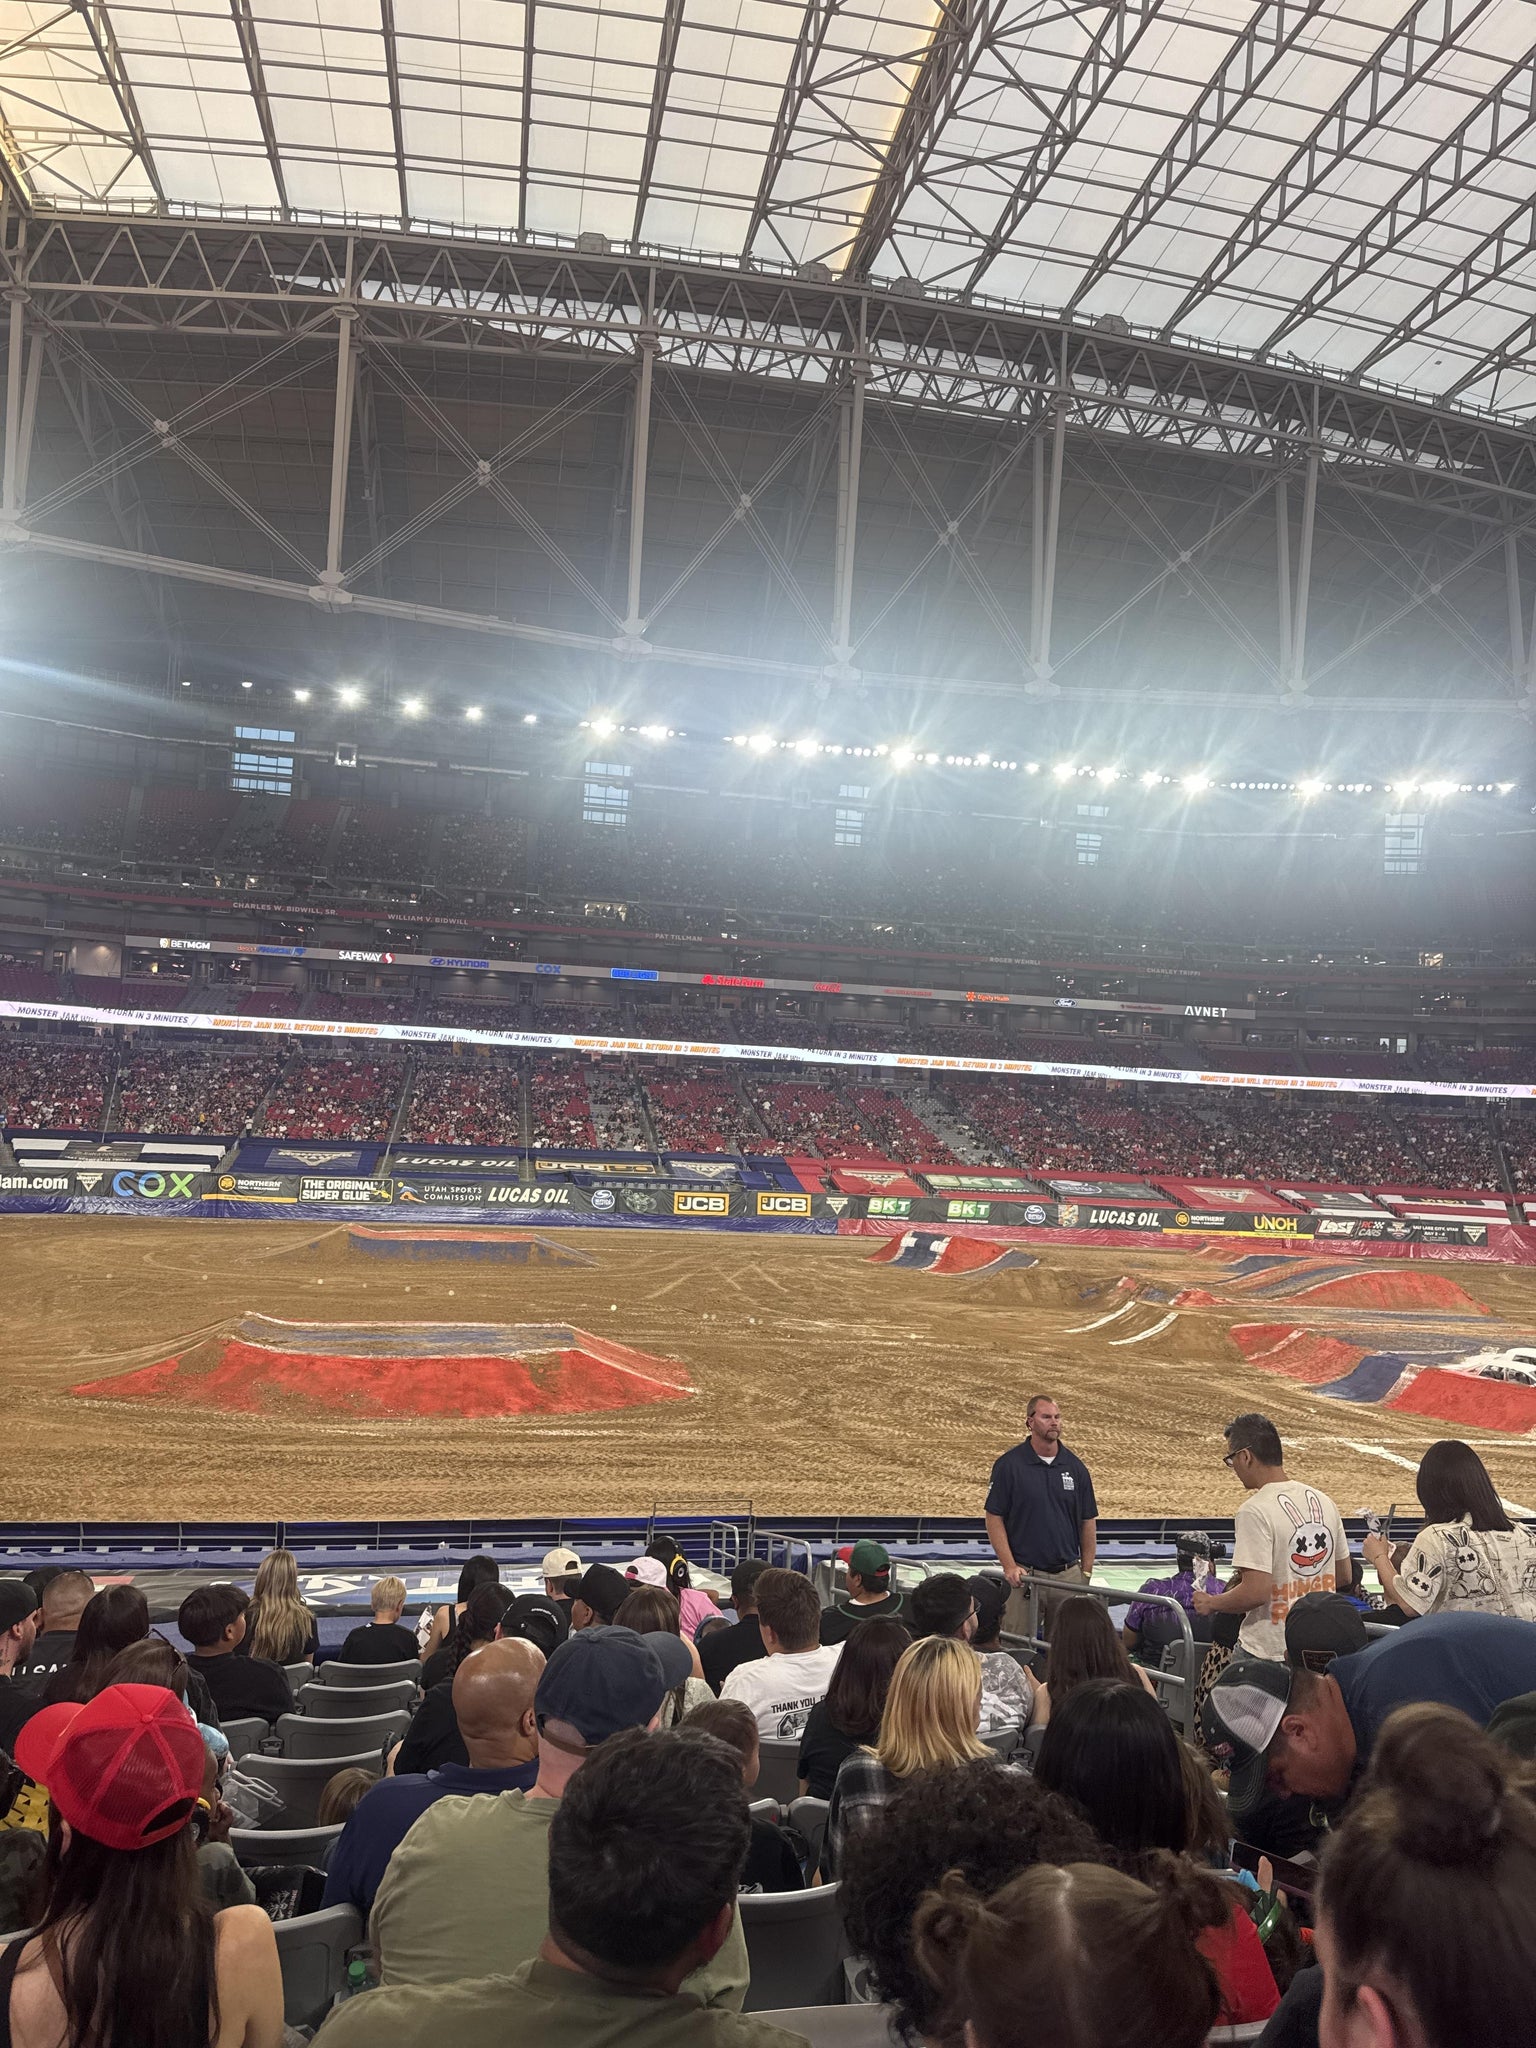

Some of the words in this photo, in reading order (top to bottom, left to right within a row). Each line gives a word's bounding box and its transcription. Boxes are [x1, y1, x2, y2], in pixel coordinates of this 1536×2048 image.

[232, 902, 272, 911] CHARLES
[273, 904, 285, 912] W.
[324, 908, 338, 916] SR.
[388, 913, 424, 922] WILLIAM
[426, 914, 433, 922] V.
[434, 916, 469, 926] BIDWILL
[654, 932, 669, 940] PAT
[671, 934, 703, 942] TILLMAN
[170, 938, 211, 950] BETMGM
[338, 950, 383, 962] SAFEWAY
[446, 958, 490, 969] HYUNDAI
[536, 964, 561, 974] COX
[1146, 967, 1178, 976] CHARLEY
[16, 1006, 58, 1018] MONSTER
[135, 1010, 144, 1019] IN
[152, 1012, 189, 1024] MINUTES
[1184, 1005, 1228, 1018] AVNET
[212, 1018, 252, 1028] MONSTER
[254, 1020, 271, 1029] JAM
[273, 1022, 292, 1030] WILL
[294, 1022, 325, 1033] RETURN
[344, 1025, 379, 1036] MINUTES
[400, 1030, 437, 1040] MONSTER
[505, 1032, 514, 1040] IN
[520, 1034, 553, 1044] MINUTES
[574, 1038, 609, 1047] MONSTER
[610, 1038, 626, 1048] JAM
[627, 1040, 644, 1050] WILL
[645, 1042, 673, 1052] RETURN
[690, 1045, 721, 1054] MINUTES
[740, 1048, 772, 1058] MONSTER
[834, 1050, 842, 1058] IN
[848, 1052, 878, 1062] MINUTES
[896, 1056, 928, 1066] MONSTER
[930, 1058, 944, 1067] JAM
[946, 1060, 961, 1068] WILL
[962, 1060, 988, 1070] RETURN
[1004, 1063, 1033, 1072] MINUTES
[1050, 1066, 1082, 1076] MONSTER
[1139, 1068, 1146, 1076] IN
[1152, 1070, 1182, 1080] MINUTES
[1358, 1082, 1392, 1092] MONSTER
[1458, 1083, 1466, 1092] IN
[1474, 1084, 1508, 1095] MINUTES
[396, 1157, 476, 1167] LUCAS
[480, 1159, 516, 1168] OIL
[112, 1170, 194, 1198] COX
[238, 1179, 282, 1188] NORTHERN
[303, 1178, 326, 1190] THE
[327, 1180, 375, 1191] ORIGINAL
[450, 1186, 482, 1194] SPORTS
[302, 1190, 338, 1200] SUPER
[341, 1190, 370, 1202] GLUE
[424, 1194, 482, 1202] COMMISSION
[488, 1186, 542, 1204] LUCAS
[678, 1196, 725, 1212] JCB
[761, 1197, 808, 1212] JCB
[868, 1198, 910, 1214] BKT
[948, 1202, 990, 1216] BKT
[1089, 1210, 1136, 1226] LUCAS
[1254, 1214, 1298, 1231] UNOH
[1360, 1221, 1374, 1229] RC
[1358, 1228, 1383, 1237] CARS
[770, 1700, 799, 1714] THANK
[800, 1697, 816, 1708] YOU
